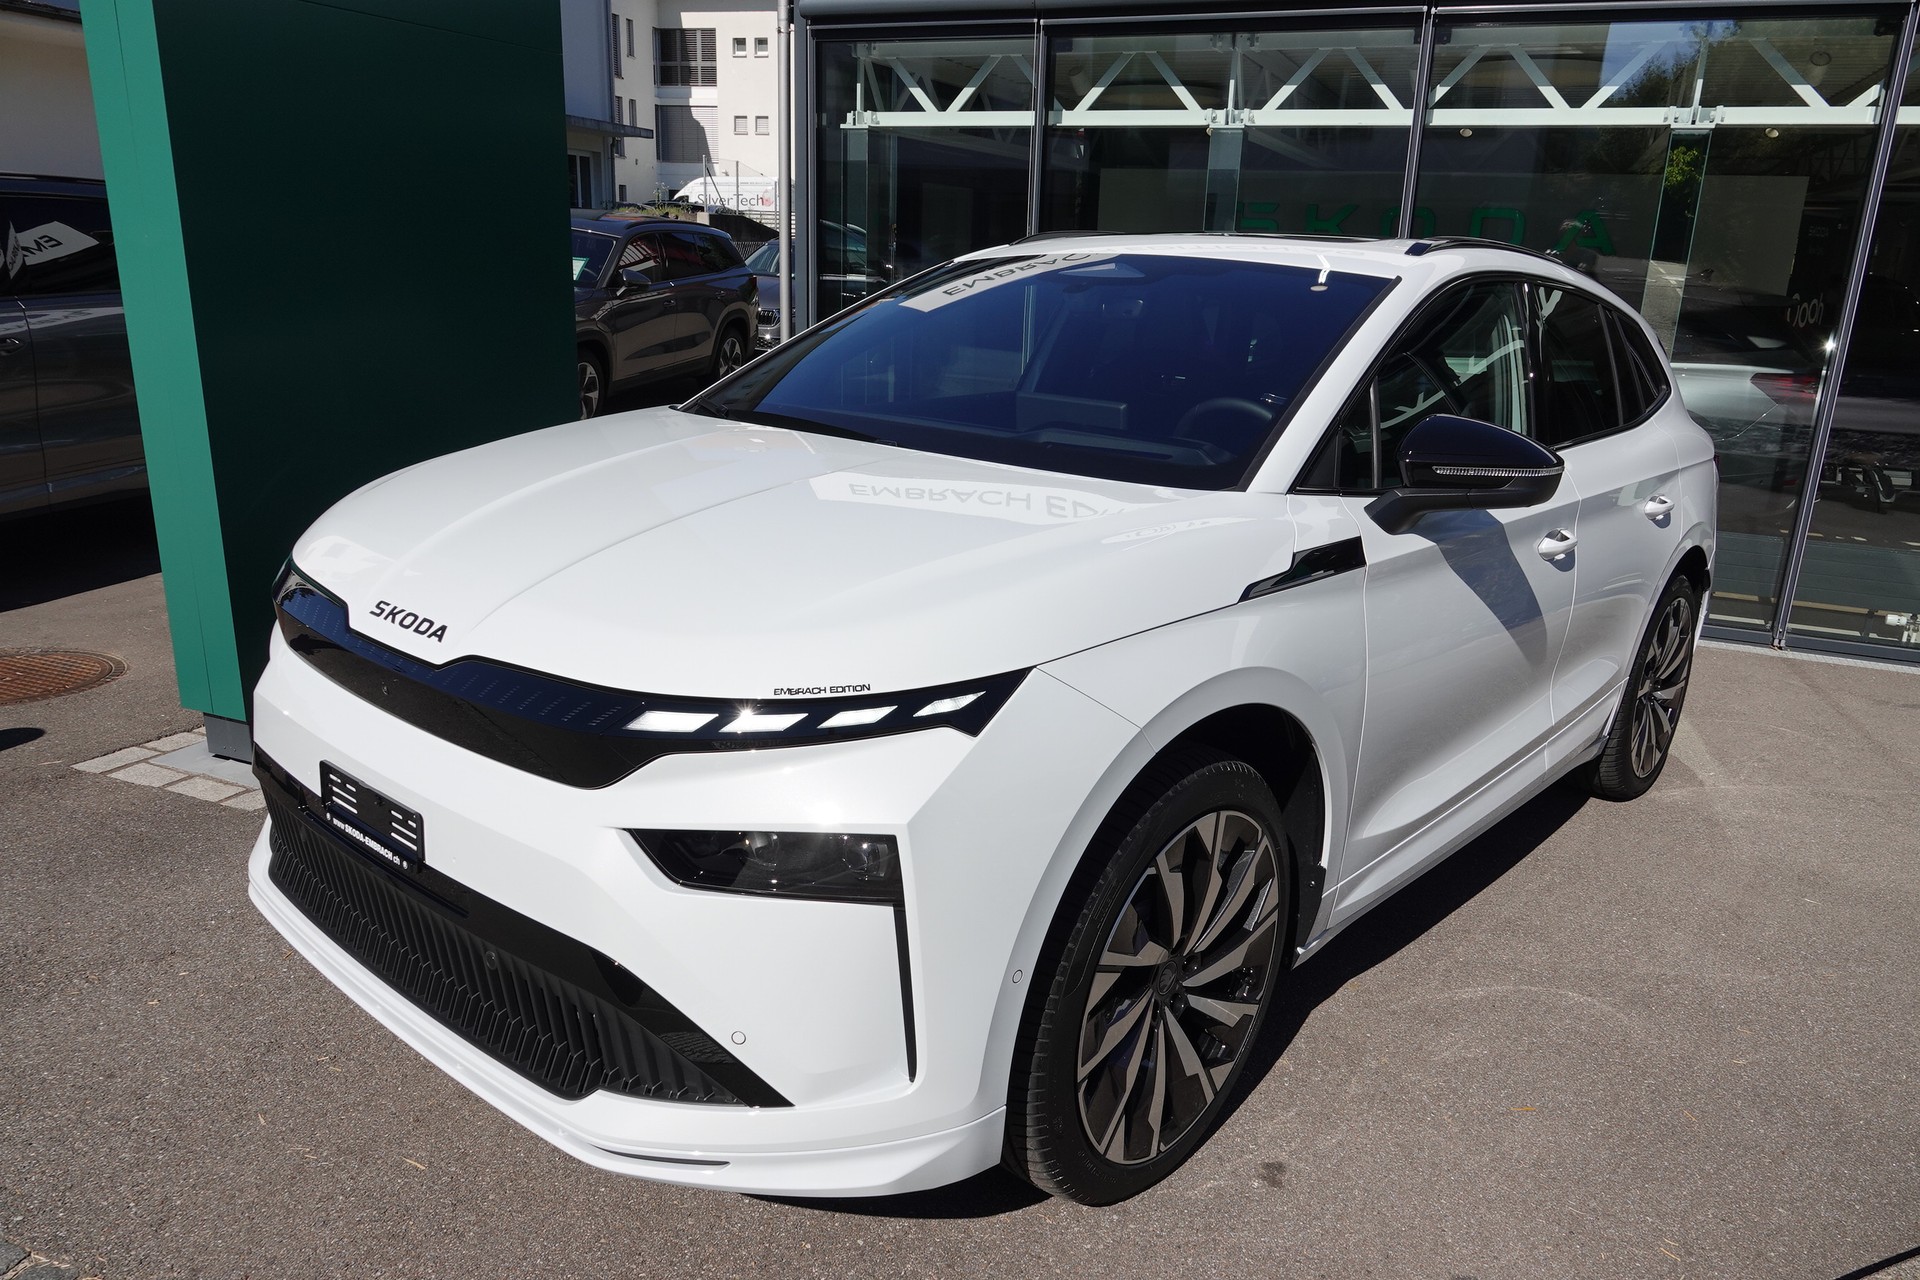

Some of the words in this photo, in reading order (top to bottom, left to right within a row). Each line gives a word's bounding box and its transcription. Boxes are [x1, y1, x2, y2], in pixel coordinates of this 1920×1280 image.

[369, 600, 447, 643] SKODA
[774, 686, 827, 696] EMBRACH
[829, 683, 871, 694] EDITION
